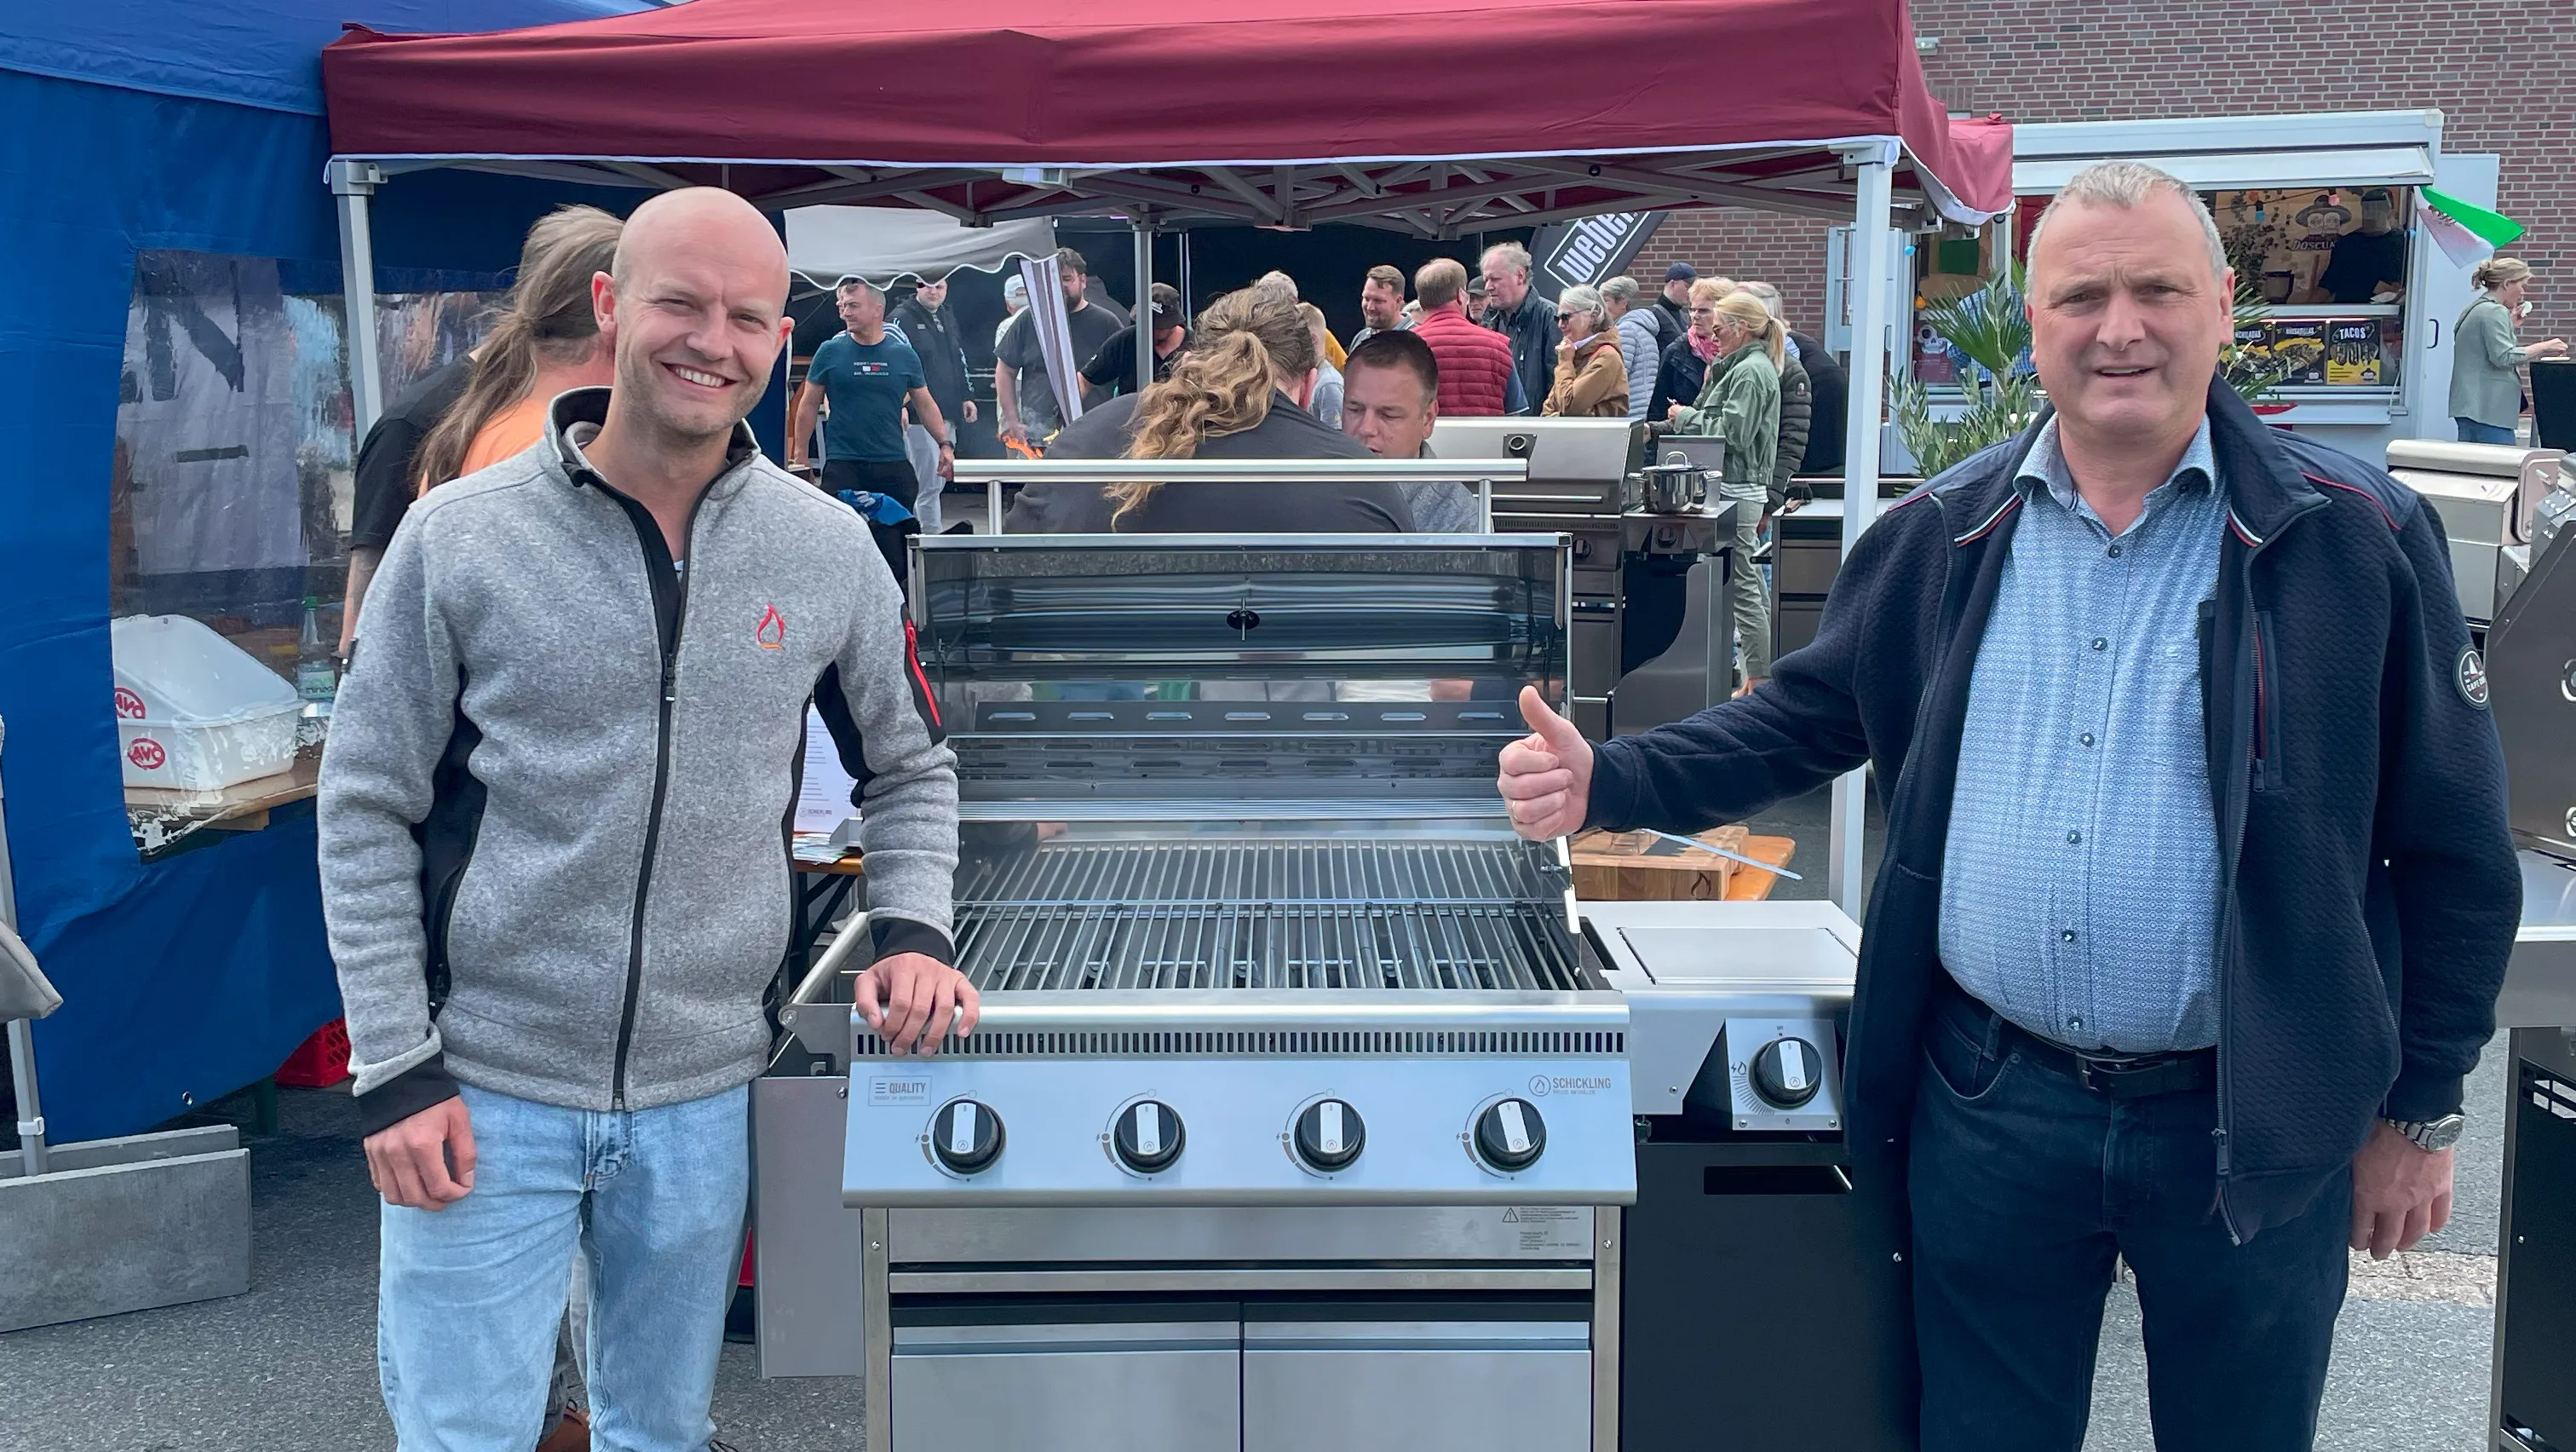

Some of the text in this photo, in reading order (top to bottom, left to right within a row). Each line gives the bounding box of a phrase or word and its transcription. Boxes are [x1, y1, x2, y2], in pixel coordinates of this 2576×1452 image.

[2339, 327, 2366, 340] TACOS
[888, 1082, 927, 1094] QUALITY
[1552, 1077, 1612, 1089] SCHICKLING
